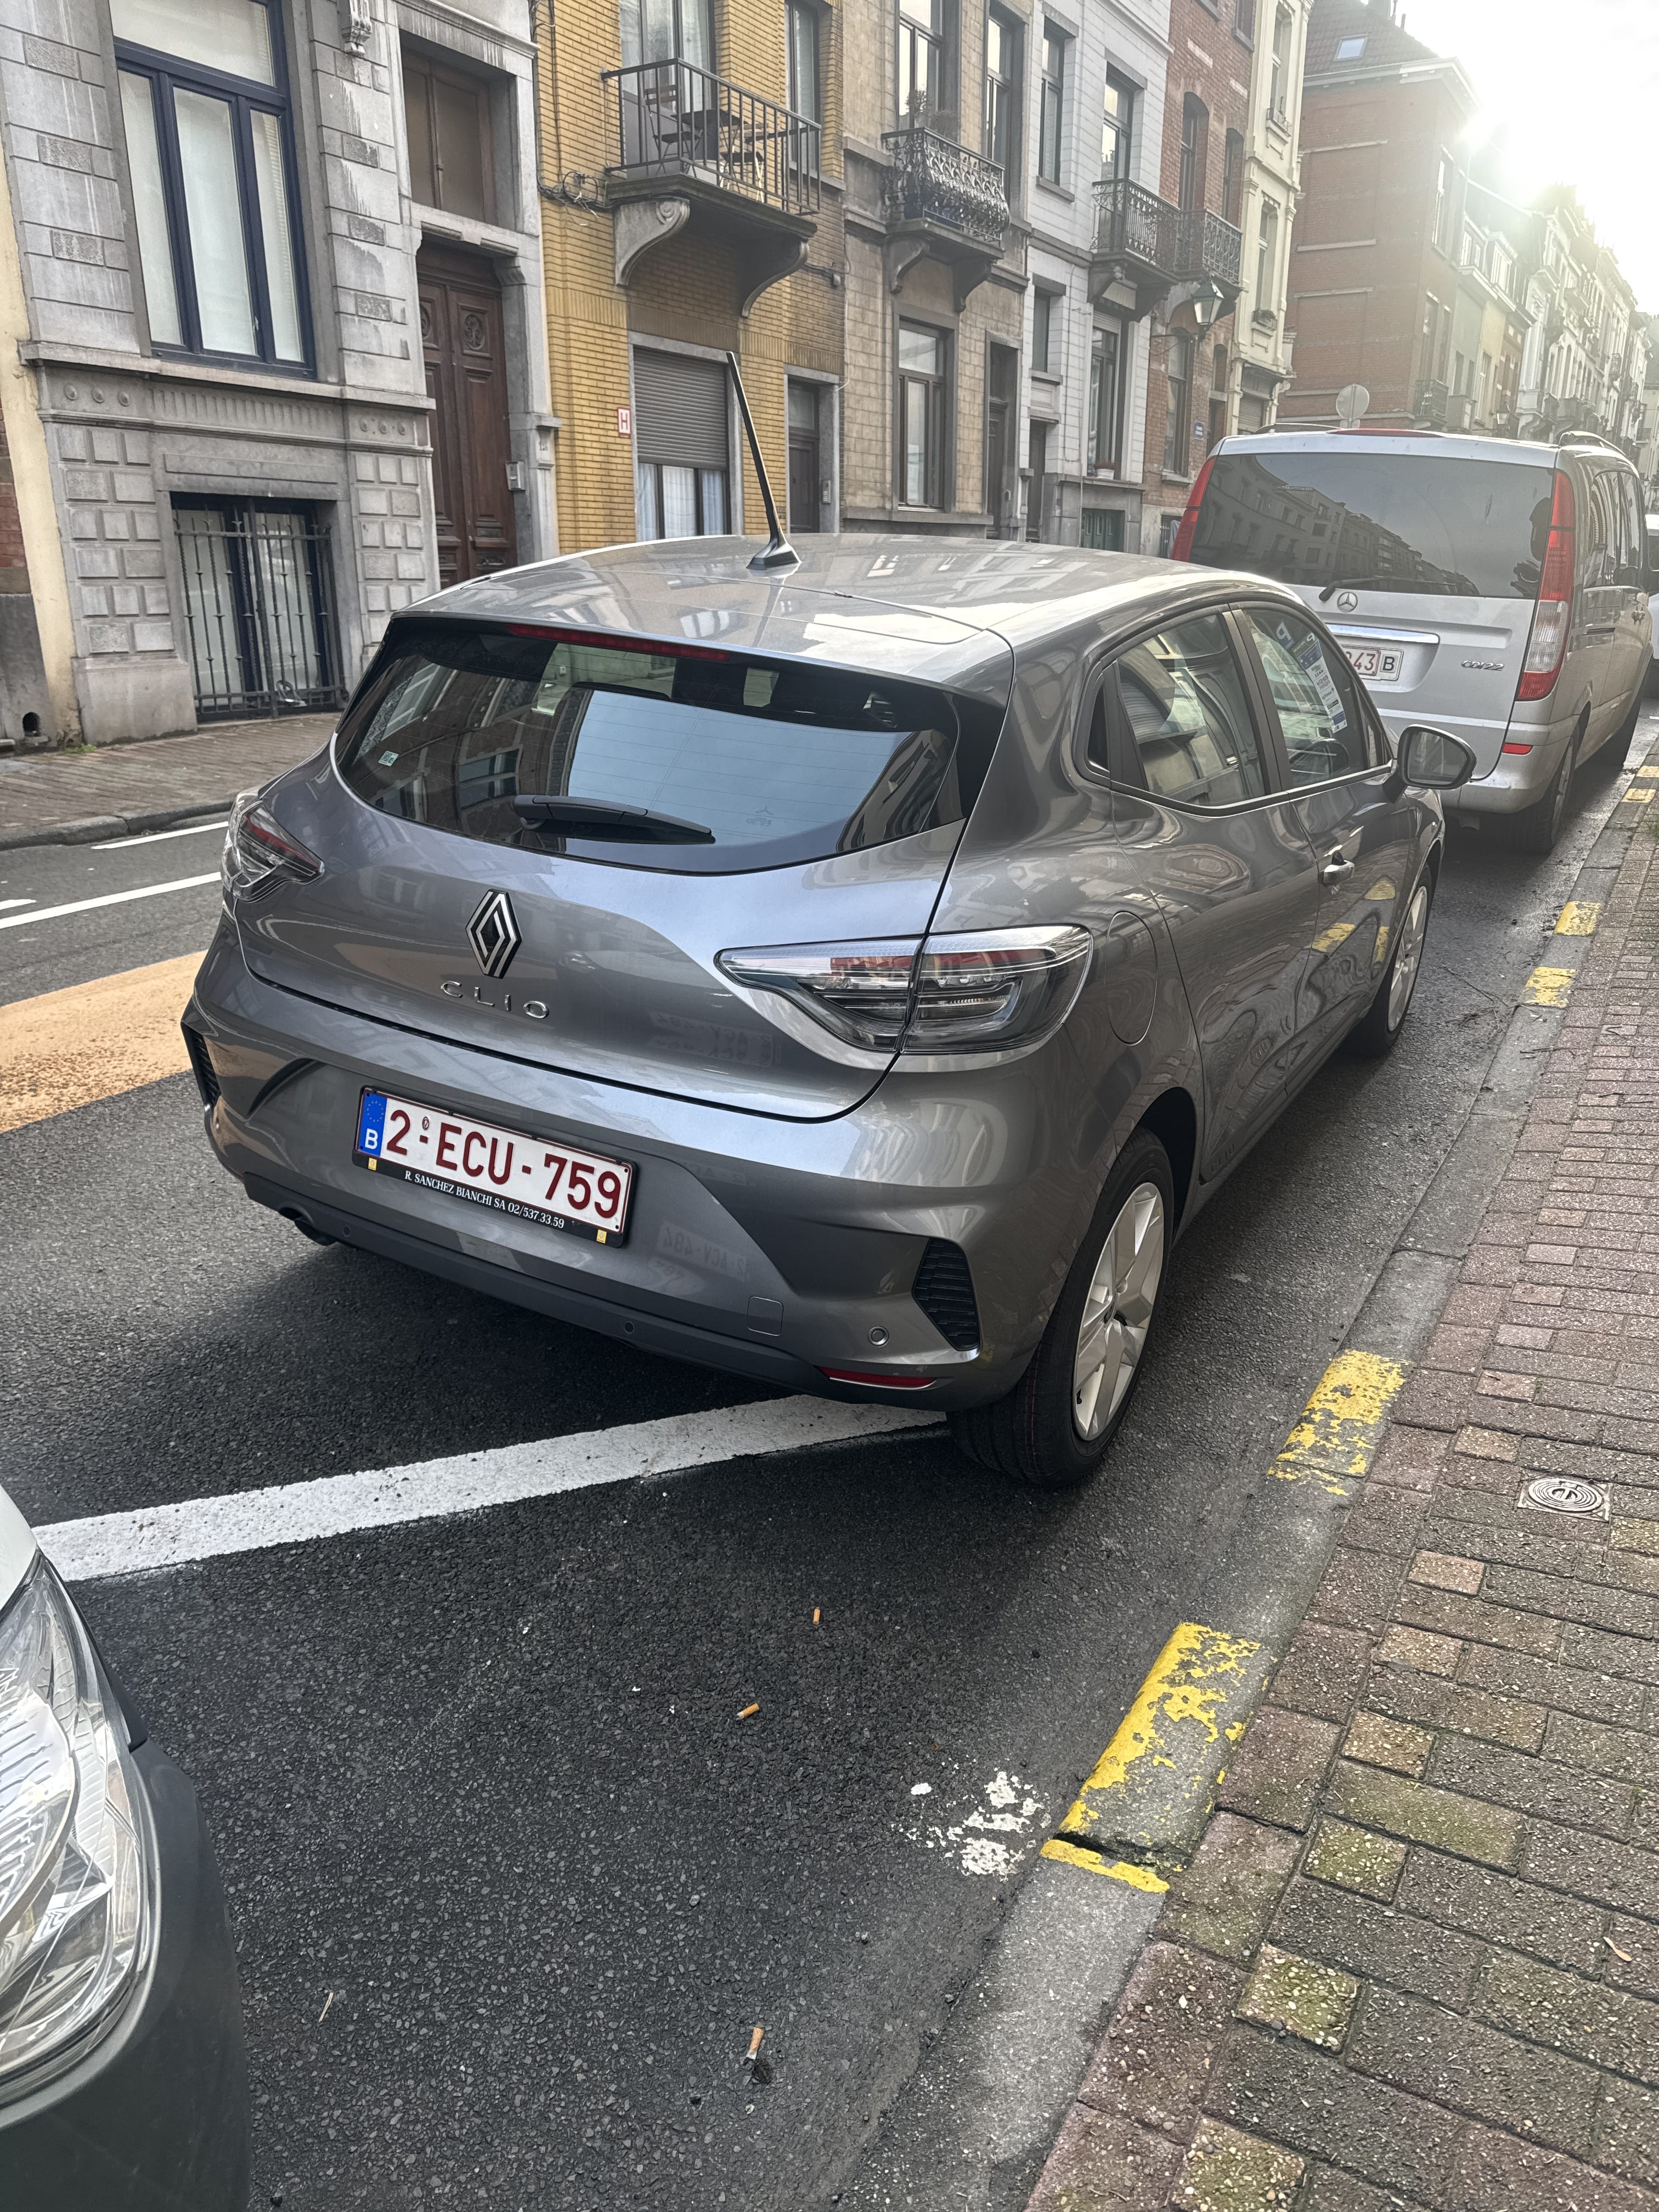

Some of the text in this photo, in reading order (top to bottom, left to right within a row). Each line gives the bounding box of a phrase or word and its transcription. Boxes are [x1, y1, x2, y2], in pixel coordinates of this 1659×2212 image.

[620, 412, 628, 431] H
[1383, 656, 1395, 671] B
[441, 980, 549, 1019] CLIO
[364, 1128, 379, 1150] B
[387, 1110, 621, 1218] 2-ECU-759
[414, 1173, 454, 1194] SANCHEZ
[456, 1186, 493, 1206] BIANCHI
[494, 1198, 506, 1210] SA
[507, 1203, 565, 1229] 02/537.33.59
